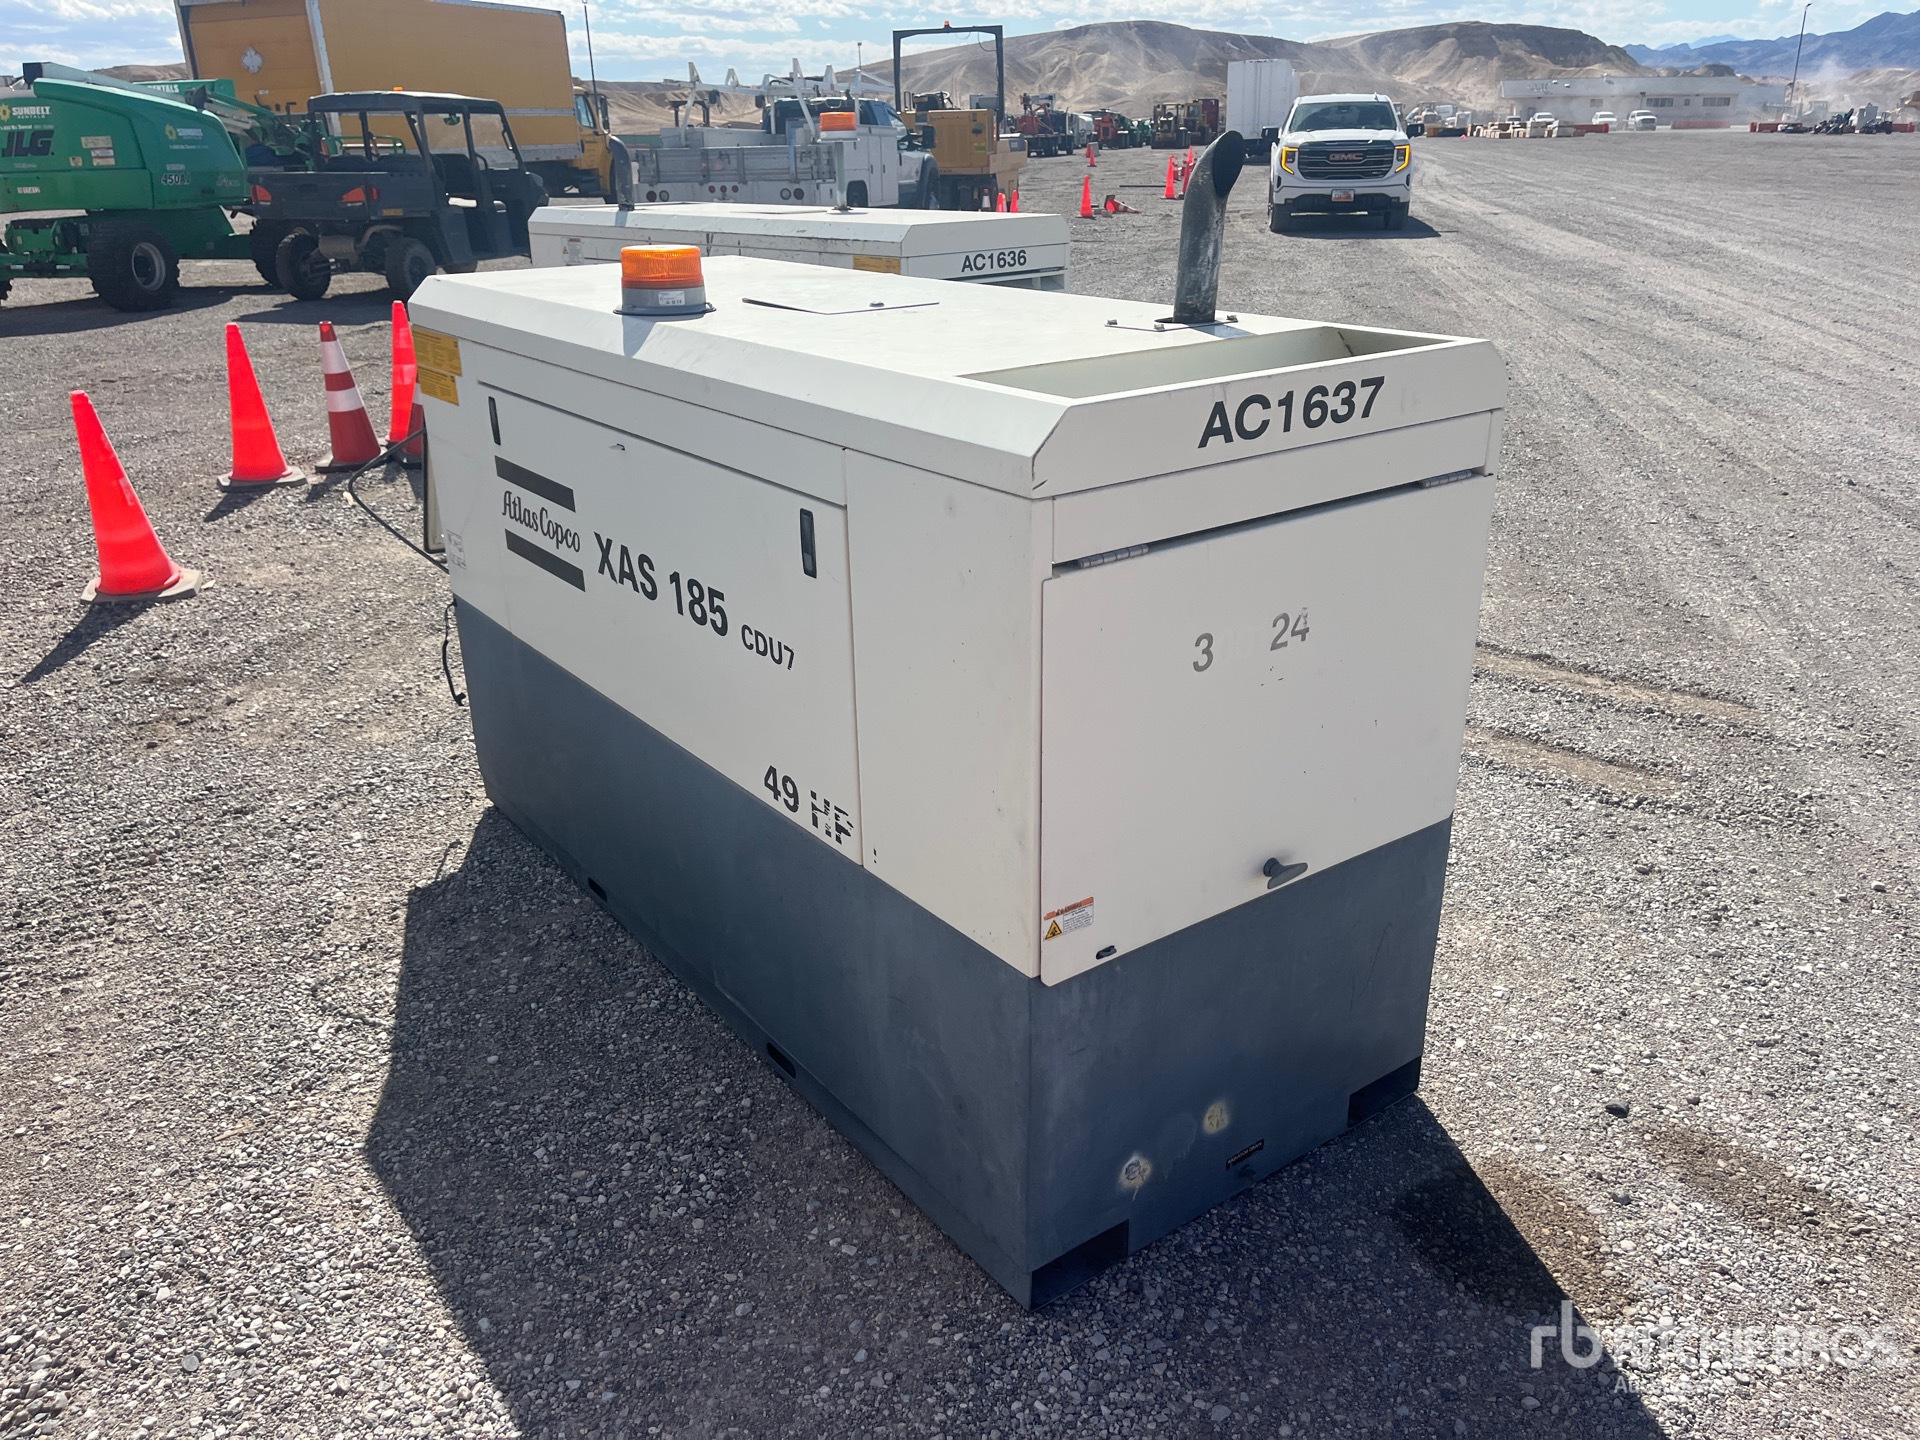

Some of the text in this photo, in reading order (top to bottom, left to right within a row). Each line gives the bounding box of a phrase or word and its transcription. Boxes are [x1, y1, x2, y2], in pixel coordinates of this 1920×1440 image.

[12, 106, 51, 116] SUNBELT
[2, 129, 54, 157] JLG
[1329, 153, 1363, 161] GMC
[961, 250, 1027, 272] AC1636
[1198, 376, 1385, 449] AC1637
[502, 490, 581, 553] Atlas Copco
[594, 531, 794, 670] XAS 185 CDU7
[764, 765, 799, 813] 49
